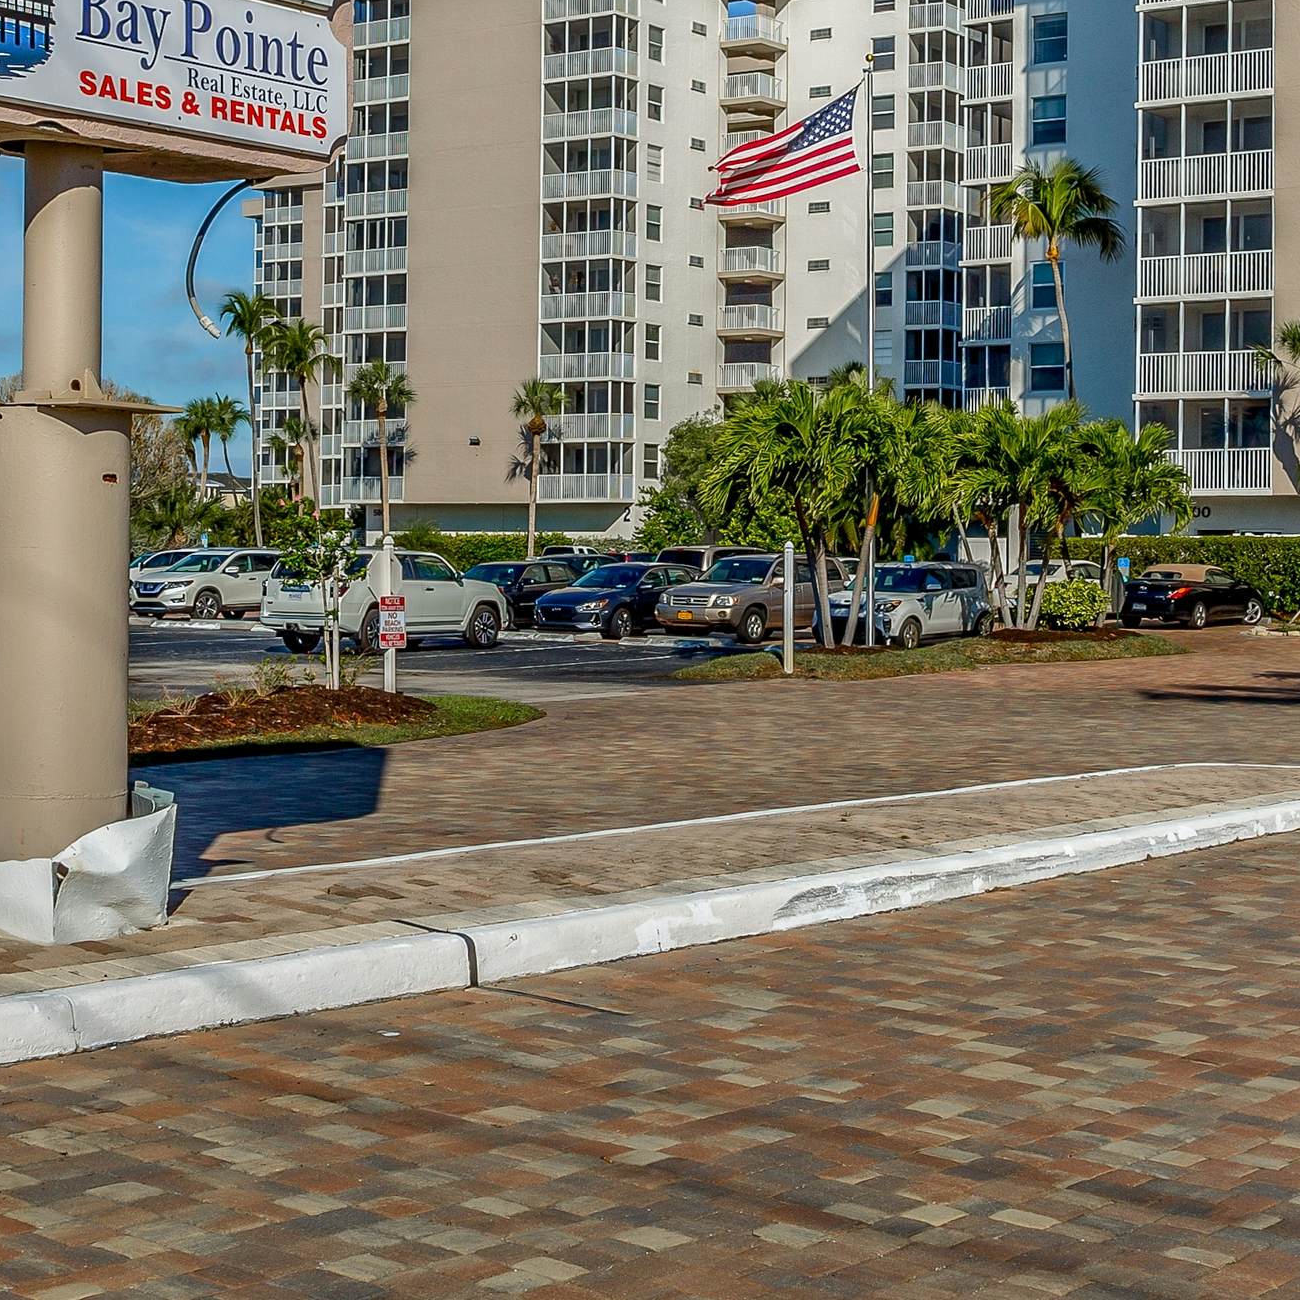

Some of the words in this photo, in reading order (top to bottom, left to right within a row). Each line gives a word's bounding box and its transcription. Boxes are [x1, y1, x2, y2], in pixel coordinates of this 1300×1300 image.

[79, 70, 172, 111] SALES
[181, 91, 201, 116] &
[211, 97, 329, 140] RENTALS
[186, 67, 225, 95] Real
[231, 76, 289, 112] Estate,
[293, 89, 329, 115] LLC
[623, 507, 631, 522] 2
[387, 612, 398, 620] NO
